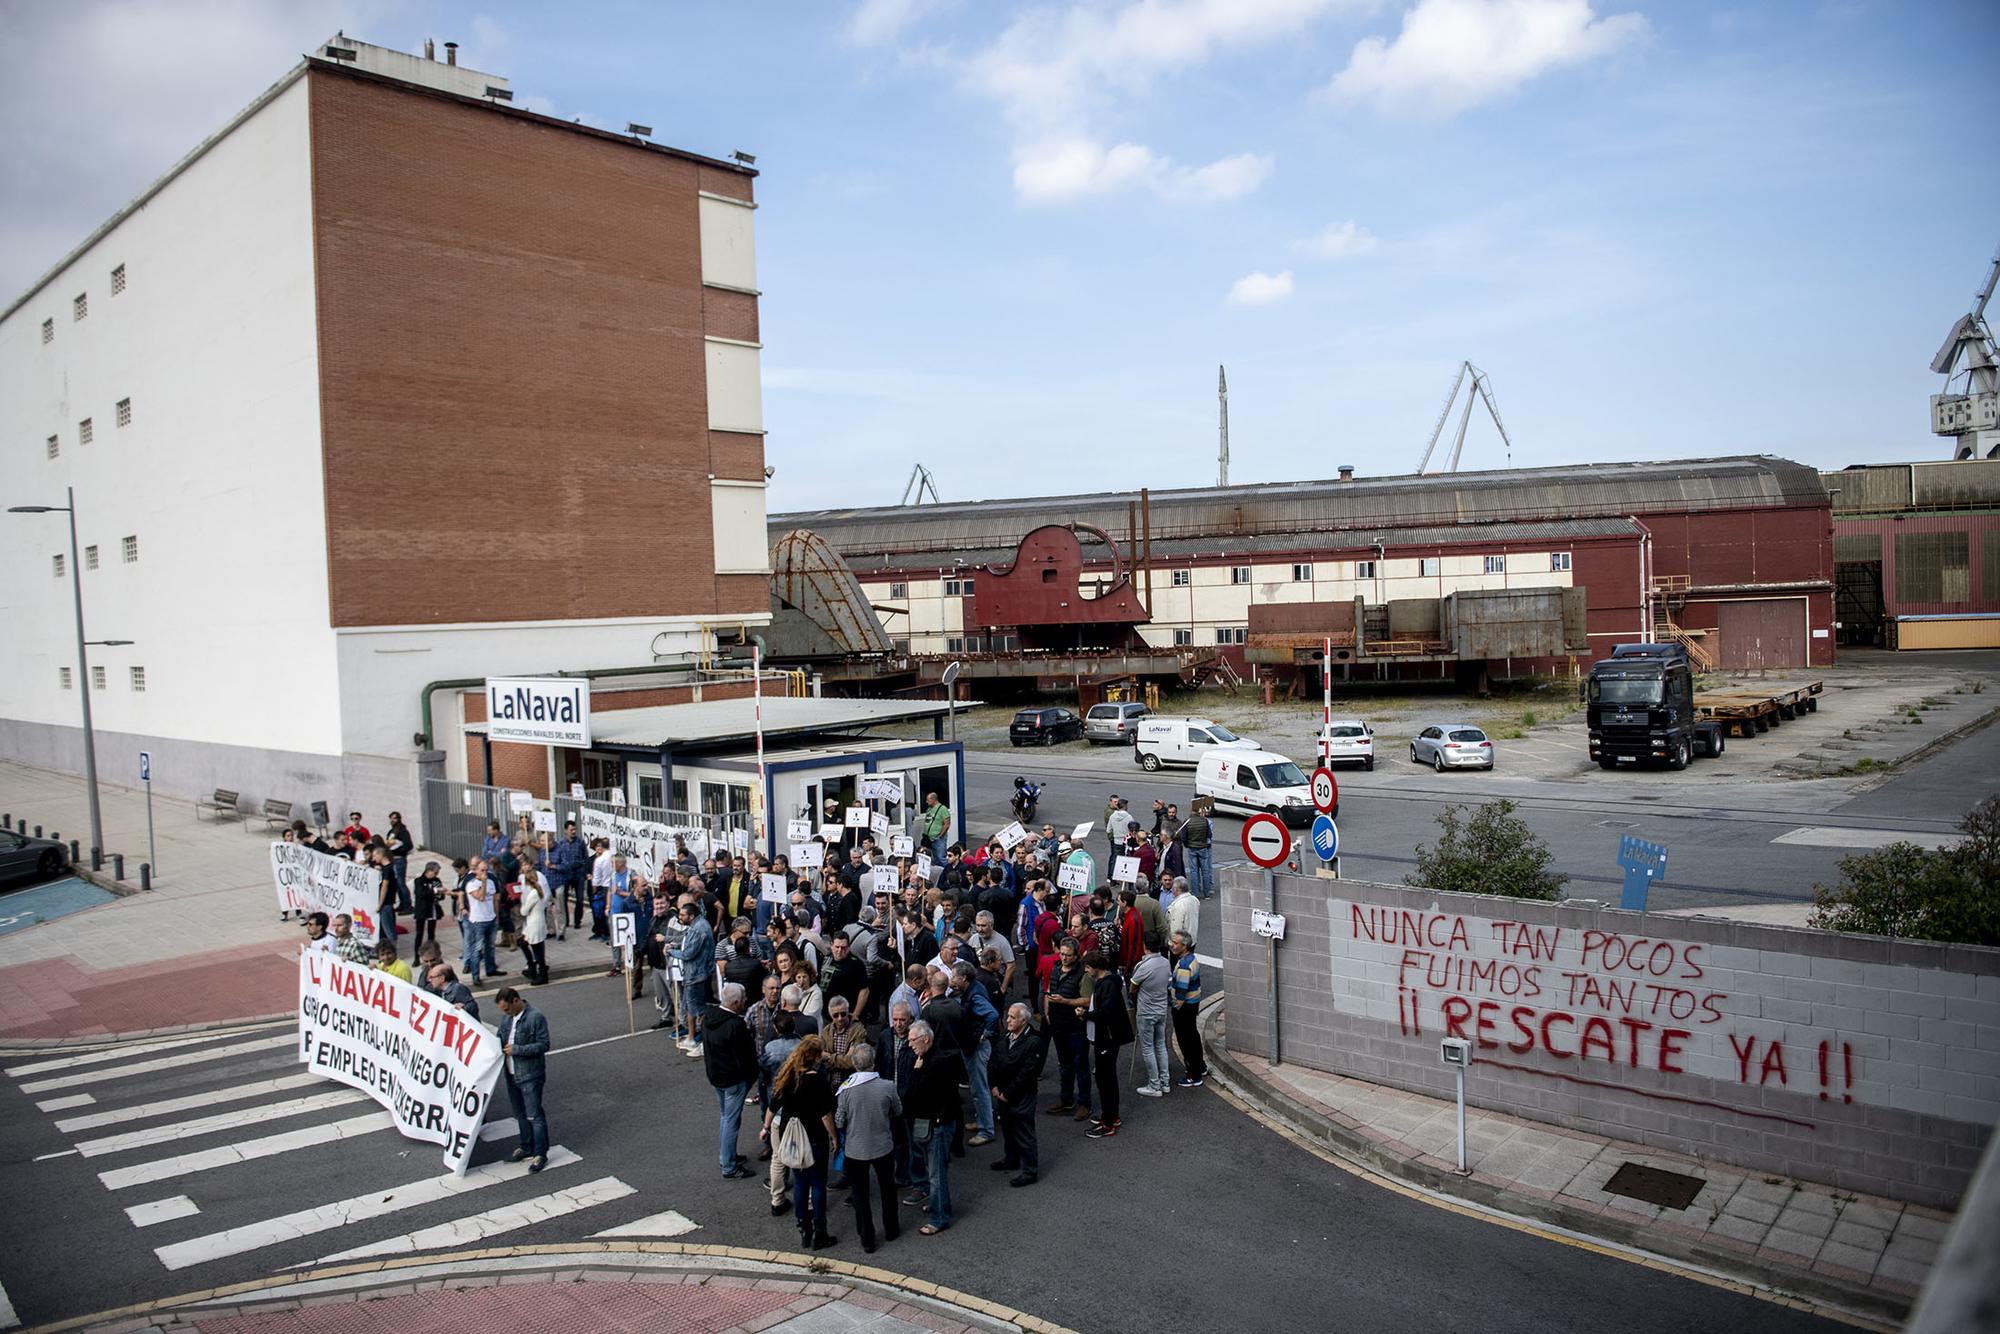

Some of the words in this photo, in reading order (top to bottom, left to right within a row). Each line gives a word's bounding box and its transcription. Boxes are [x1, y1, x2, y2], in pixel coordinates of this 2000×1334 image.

[492, 687, 580, 723] LaNaval
[493, 727, 532, 737] CONSTRUCCIONES
[533, 730, 554, 739] NAVALES
[555, 731, 564, 739] DEL
[565, 732, 582, 741] NORTE
[142, 755, 148, 778] P
[1317, 783, 1329, 798] 30
[1352, 904, 1469, 951] NUNCA
[1491, 922, 1560, 961] TAN
[1580, 930, 1704, 979] POCOS
[330, 963, 401, 1019] NAVAL
[408, 993, 431, 1036] EZ
[430, 1009, 482, 1067] ITXI
[1400, 950, 1542, 997] FUIMOS
[1561, 973, 1728, 1024] TANTOS
[1441, 996, 1692, 1073] RESCATE
[1729, 1034, 1787, 1085] YA
[316, 1041, 376, 1086] EMPLEO
[379, 1067, 397, 1099] EN
